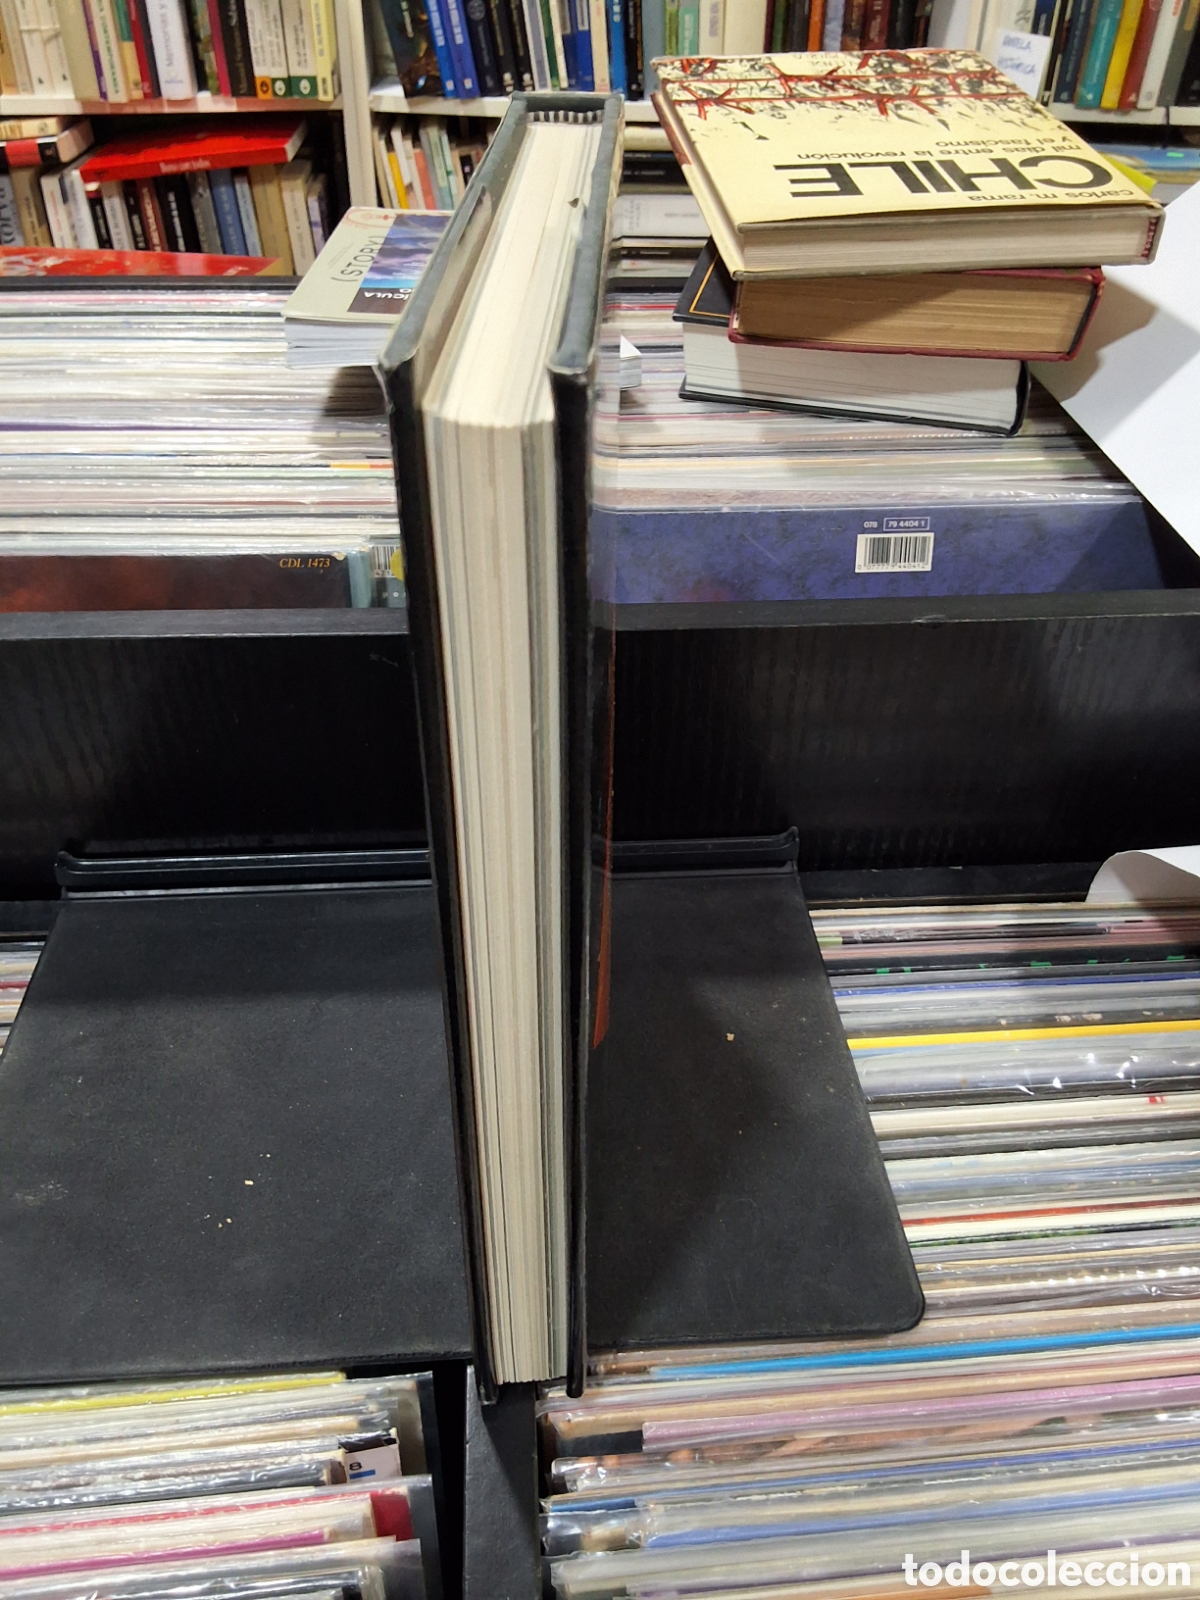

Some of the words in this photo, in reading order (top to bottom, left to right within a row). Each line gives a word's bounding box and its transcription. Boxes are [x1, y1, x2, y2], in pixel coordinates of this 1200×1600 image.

[935, 138, 1032, 147] fascismo
[939, 147, 994, 156] entre
[1052, 144, 1083, 153] mil
[797, 151, 907, 161] revolución
[914, 150, 934, 158] la
[773, 155, 1113, 198] CHILE
[1065, 189, 1134, 199] carlos
[899, 520, 919, 528] 4404
[279, 558, 305, 569] CDL
[307, 558, 331, 568] 1473
[349, 1461, 362, 1471] 8
